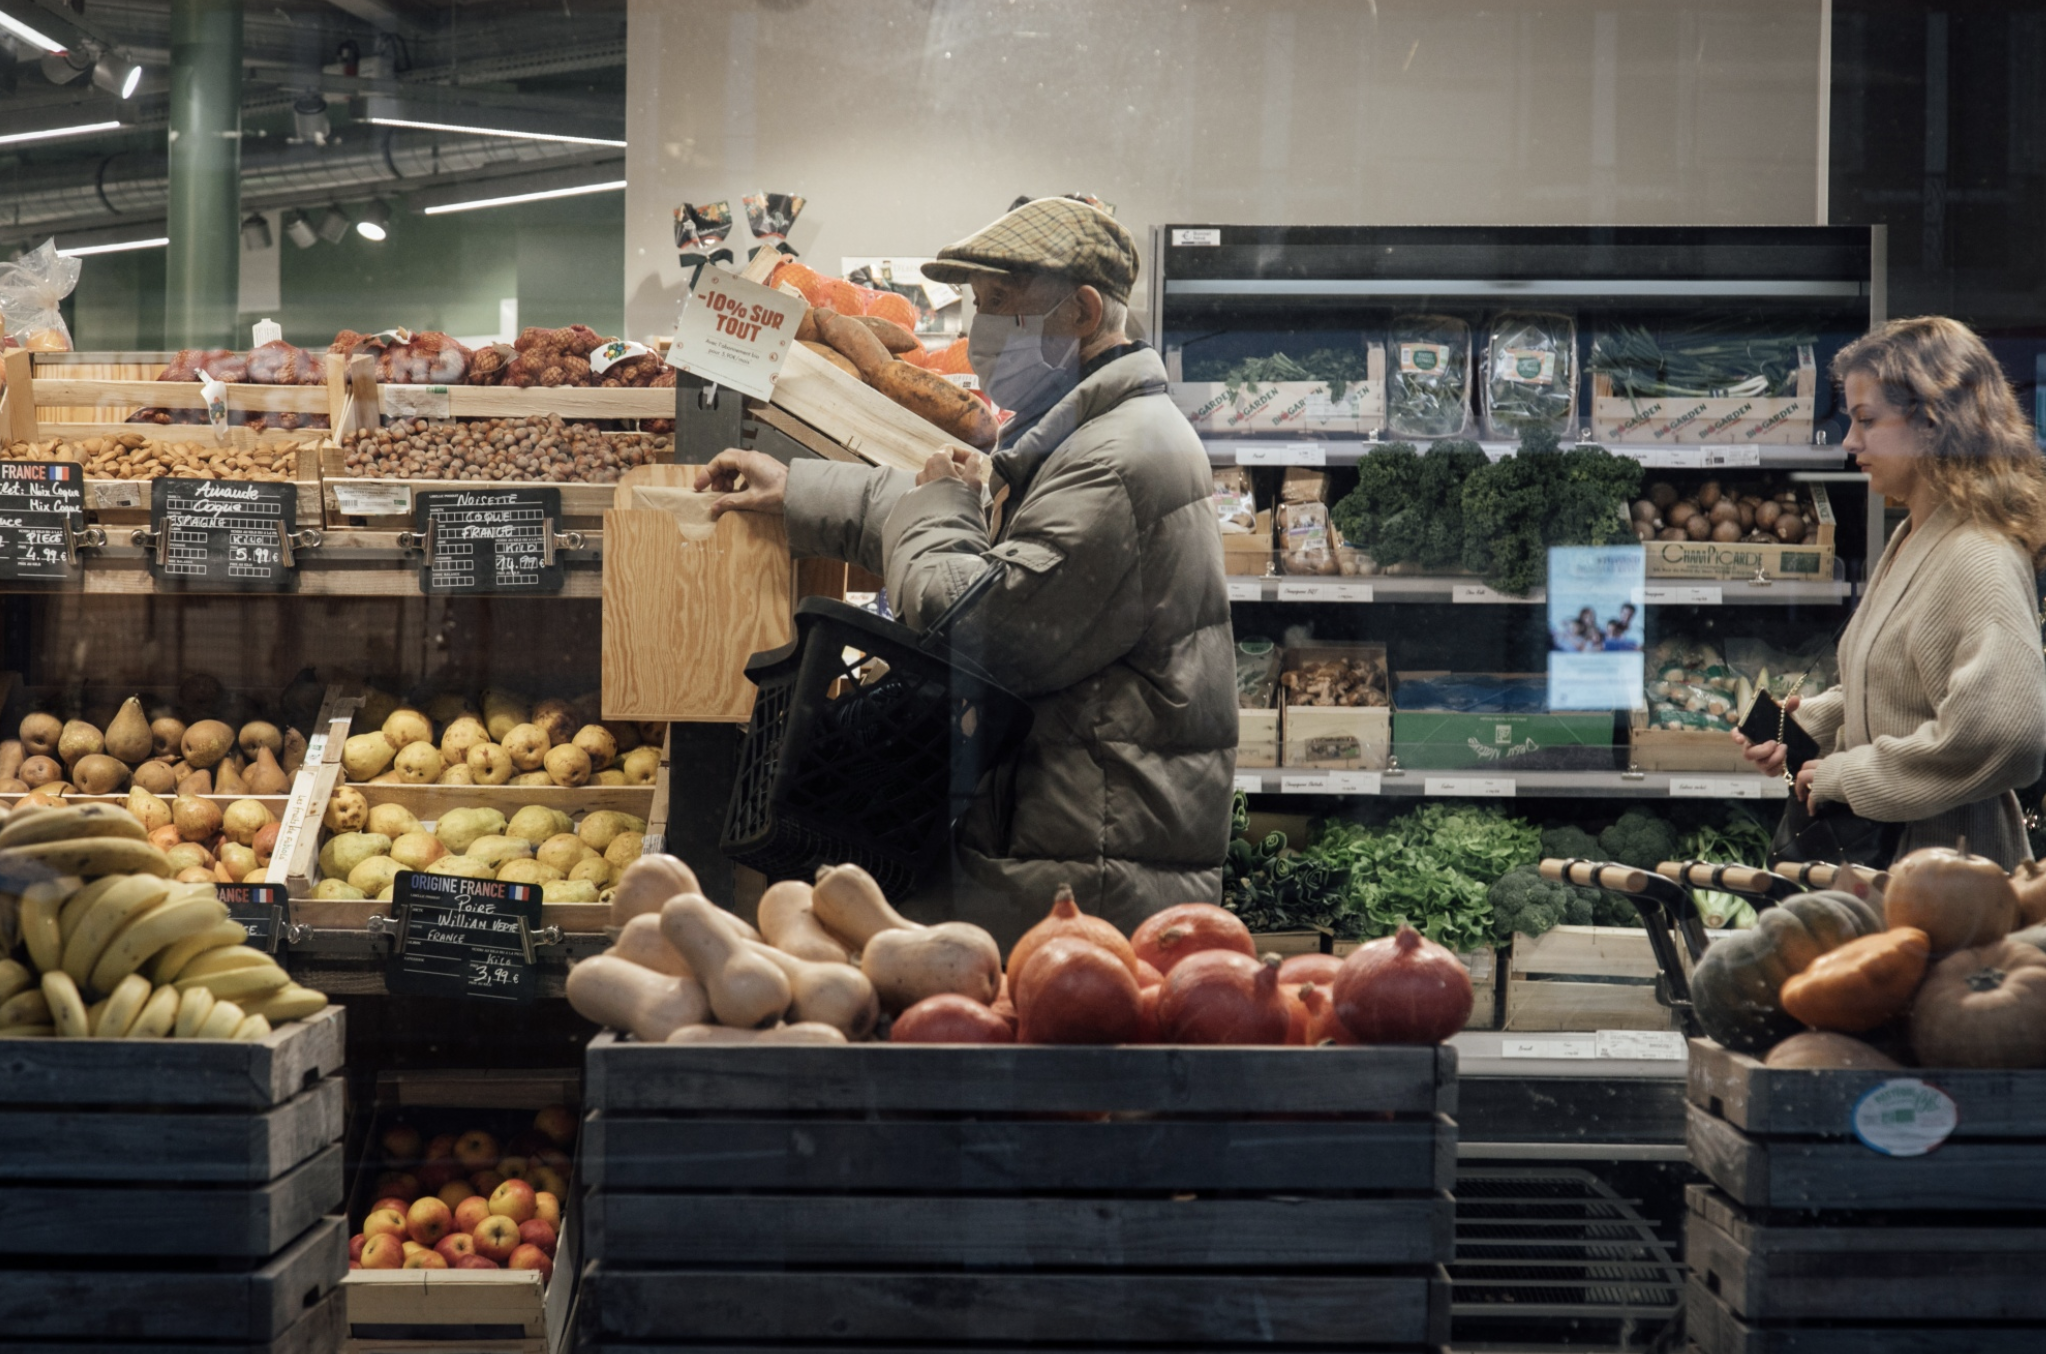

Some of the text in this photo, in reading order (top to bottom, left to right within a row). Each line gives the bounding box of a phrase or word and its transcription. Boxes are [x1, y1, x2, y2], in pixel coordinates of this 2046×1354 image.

[698, 291, 785, 330] -10% SUR
[716, 314, 762, 342] TOUT
[2, 465, 46, 480] FRANCE
[52, 481, 80, 502] Coque
[195, 481, 259, 500] Amande
[53, 499, 82, 519] Coque
[193, 499, 242, 518] Coque
[26, 546, 67, 563] 4.99 €
[235, 547, 278, 564] 5.99 €
[539, 558, 545, 568] €
[411, 874, 505, 898] ORIGINE FRANCE
[427, 929, 466, 944] FRANCE
[473, 965, 519, 984] 3,99 €
